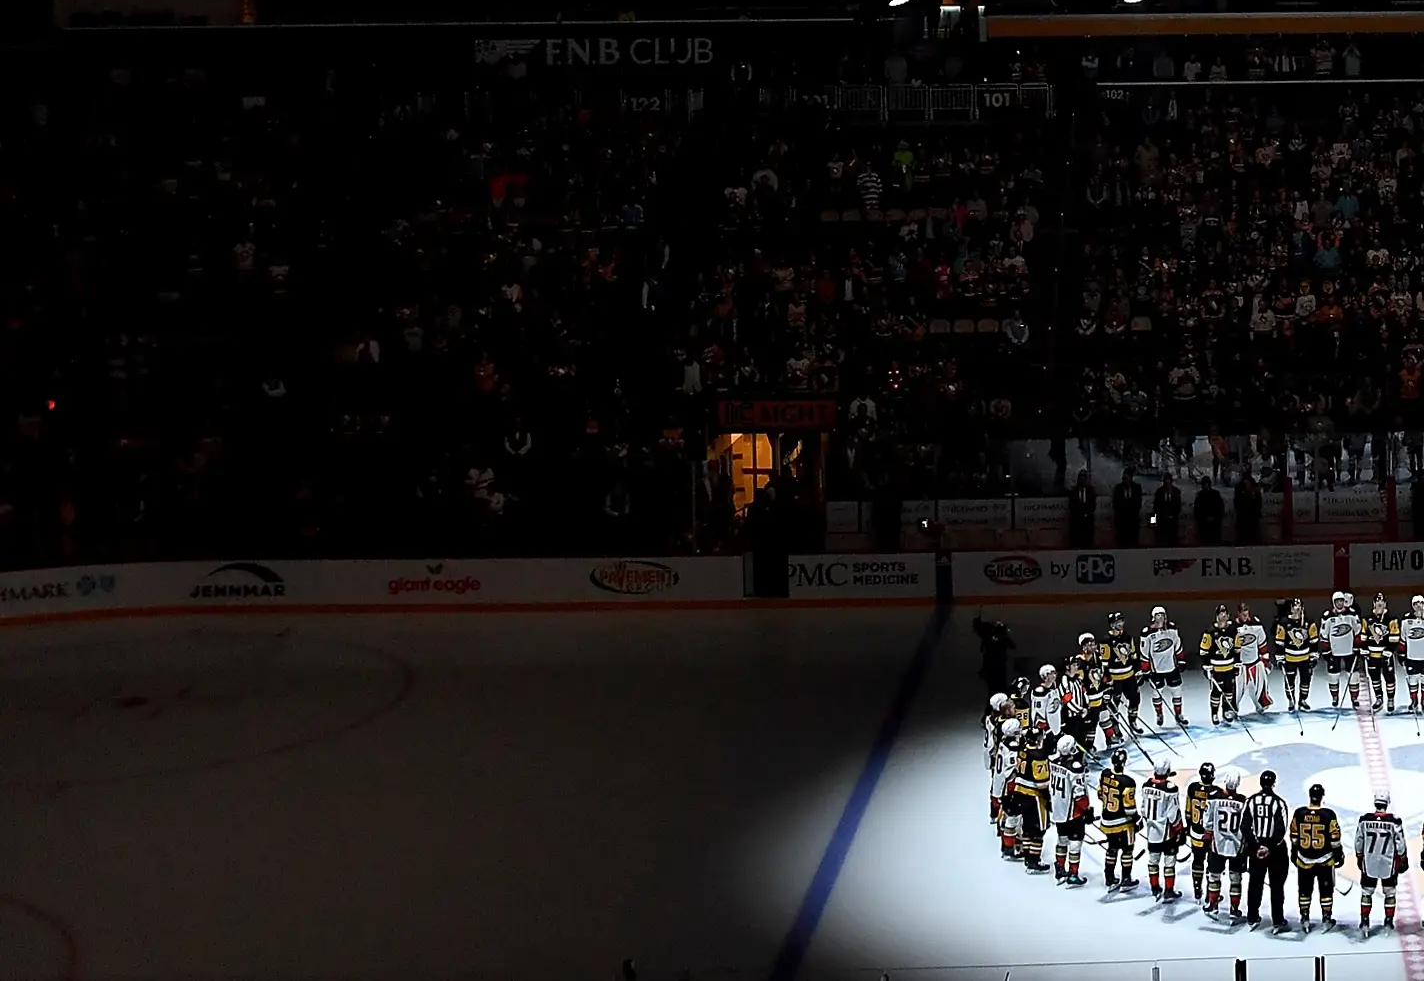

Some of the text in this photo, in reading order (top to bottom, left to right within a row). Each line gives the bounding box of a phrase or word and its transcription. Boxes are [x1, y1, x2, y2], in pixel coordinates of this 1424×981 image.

[630, 37, 714, 66] CLUB
[630, 96, 661, 112] 122
[983, 92, 1011, 108] 101
[853, 561, 906, 573] SPORTS
[984, 564, 1042, 578] Glidden
[1050, 561, 1070, 579] by
[1201, 557, 1256, 577] F.N.B.
[1372, 550, 1407, 571] PLAY
[388, 575, 481, 595] giant eagle
[853, 574, 919, 586] MEDICINE
[189, 585, 285, 598] JENNMAR
[1050, 773, 1066, 799] 44
[1256, 804, 1270, 818] 81
[1217, 810, 1240, 833] 20
[1299, 823, 1326, 850] 55
[1366, 831, 1392, 855] 77
